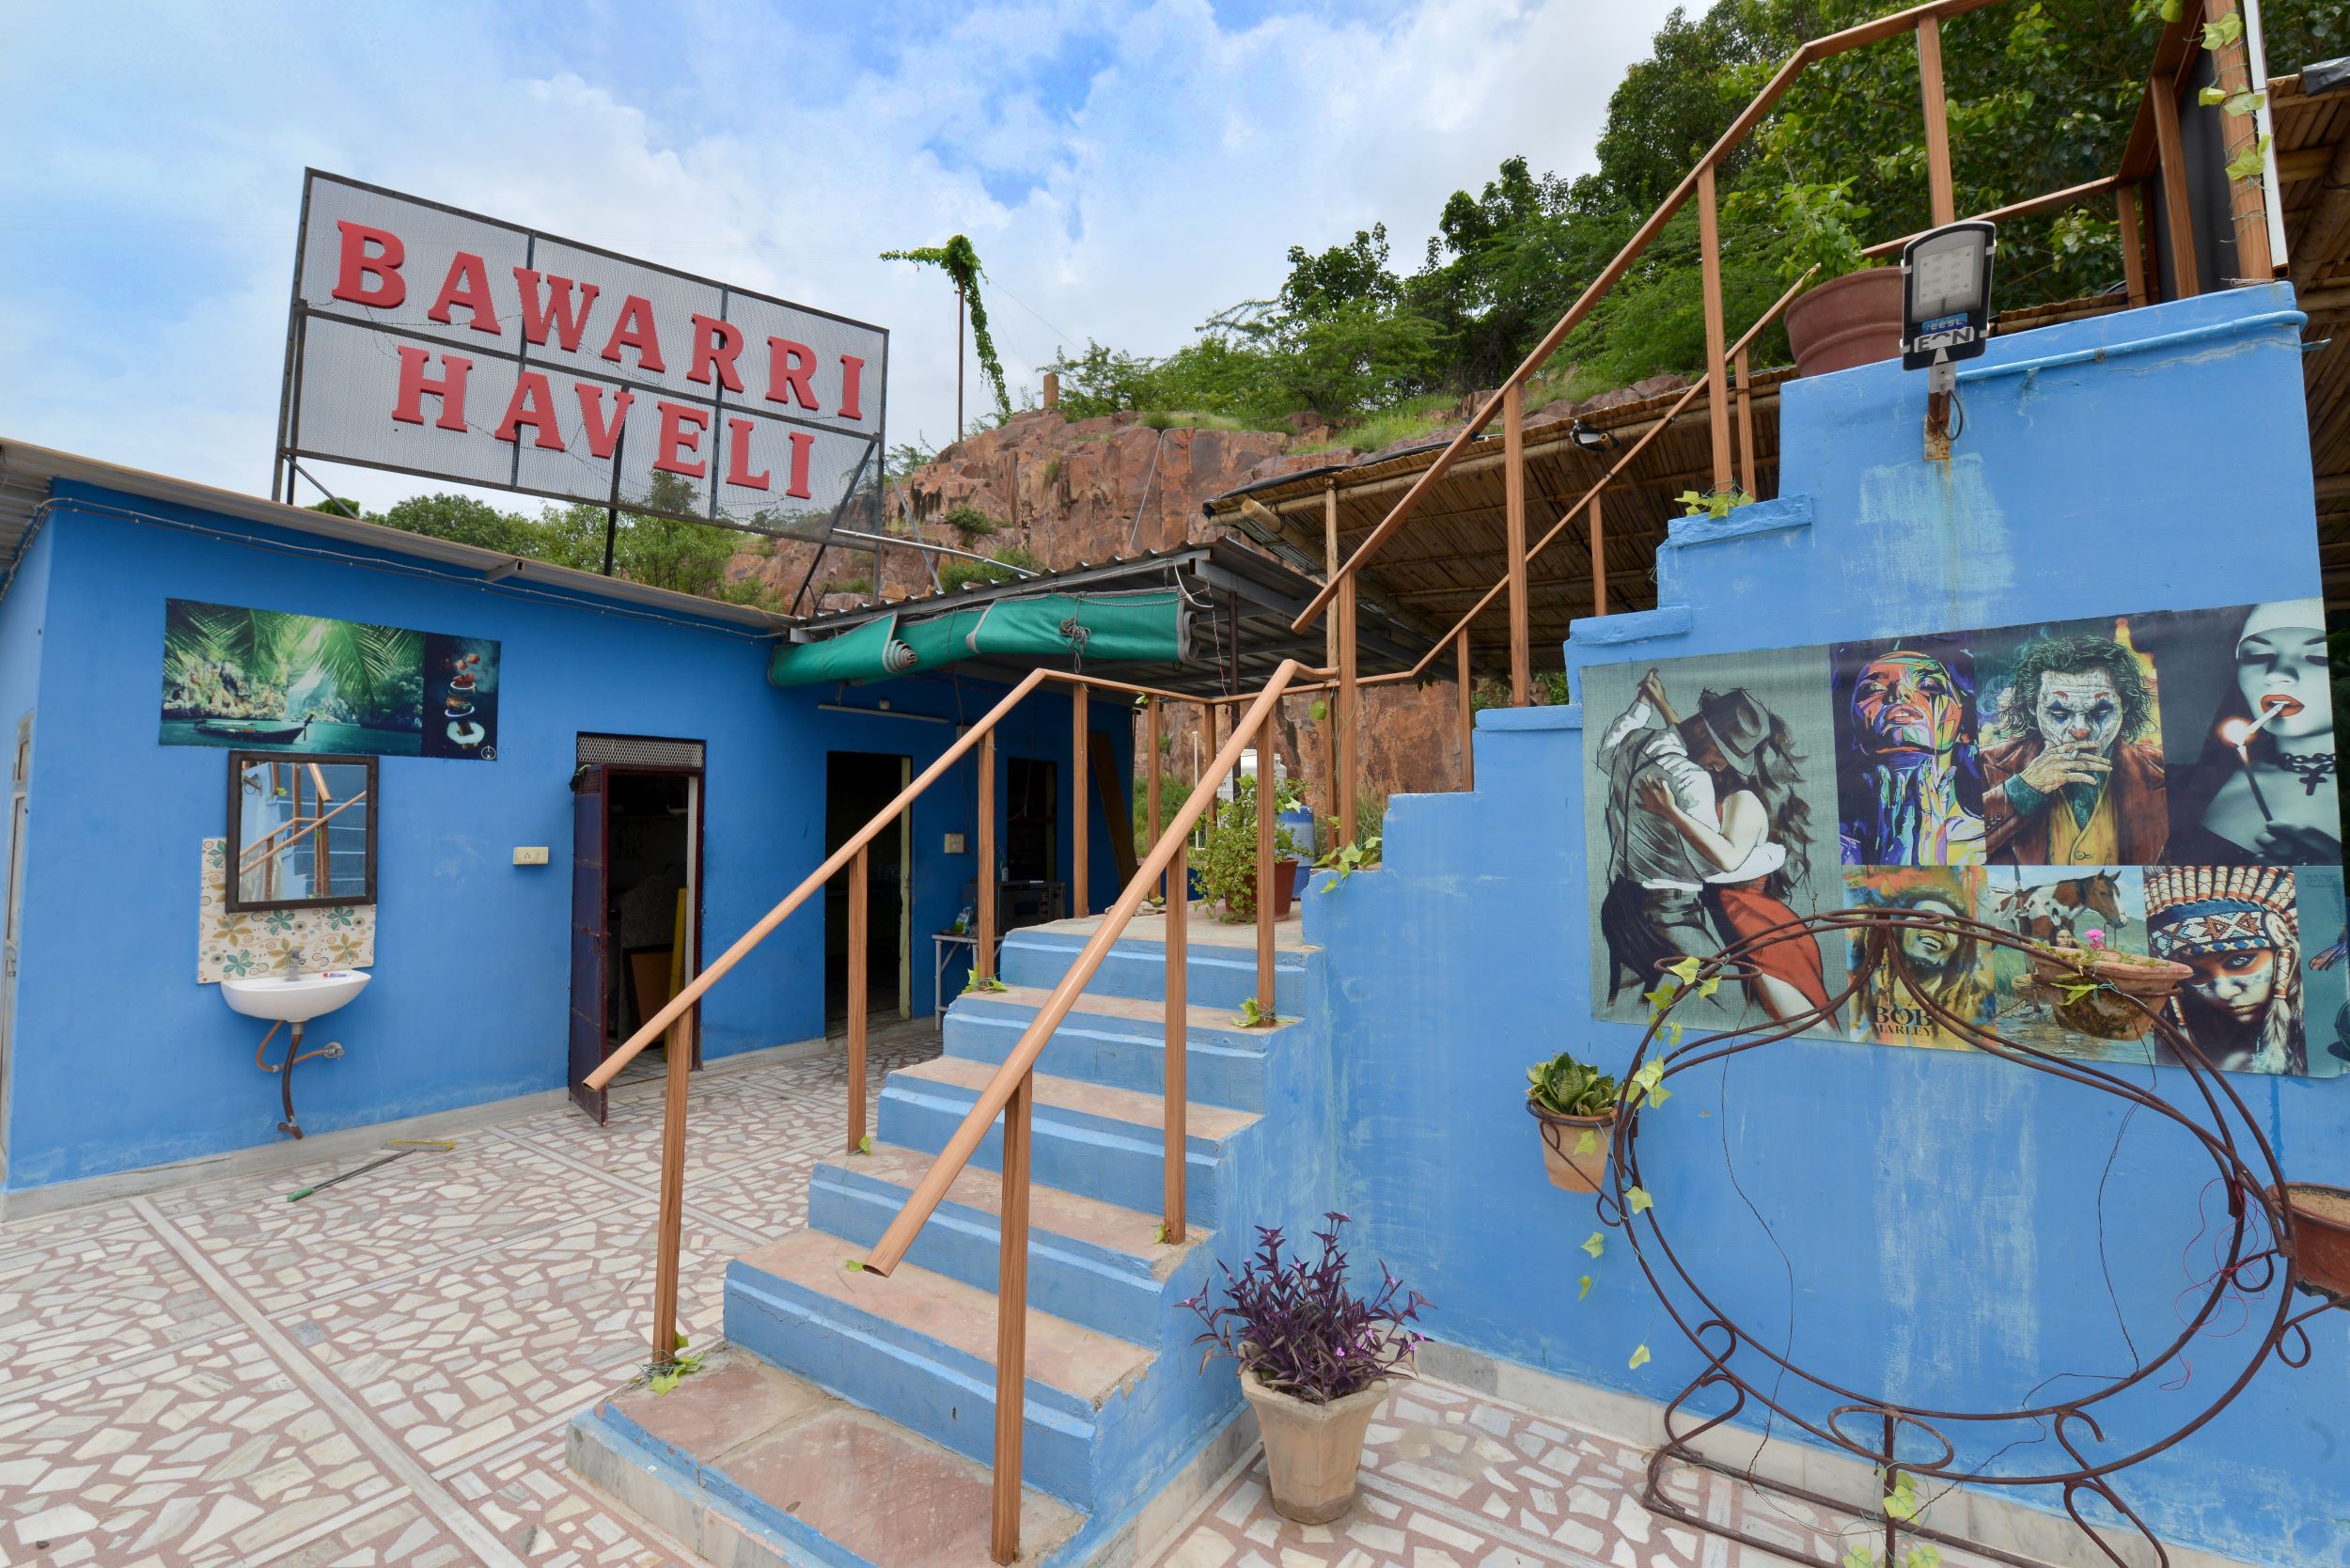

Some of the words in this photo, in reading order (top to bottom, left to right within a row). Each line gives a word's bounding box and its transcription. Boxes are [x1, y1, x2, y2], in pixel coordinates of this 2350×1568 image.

[331, 219, 865, 420] BAWARRI
[391, 345, 816, 500] HAVELI
[1872, 1005, 1934, 1027] BOB
[1873, 1024, 1931, 1036] MARLEY
